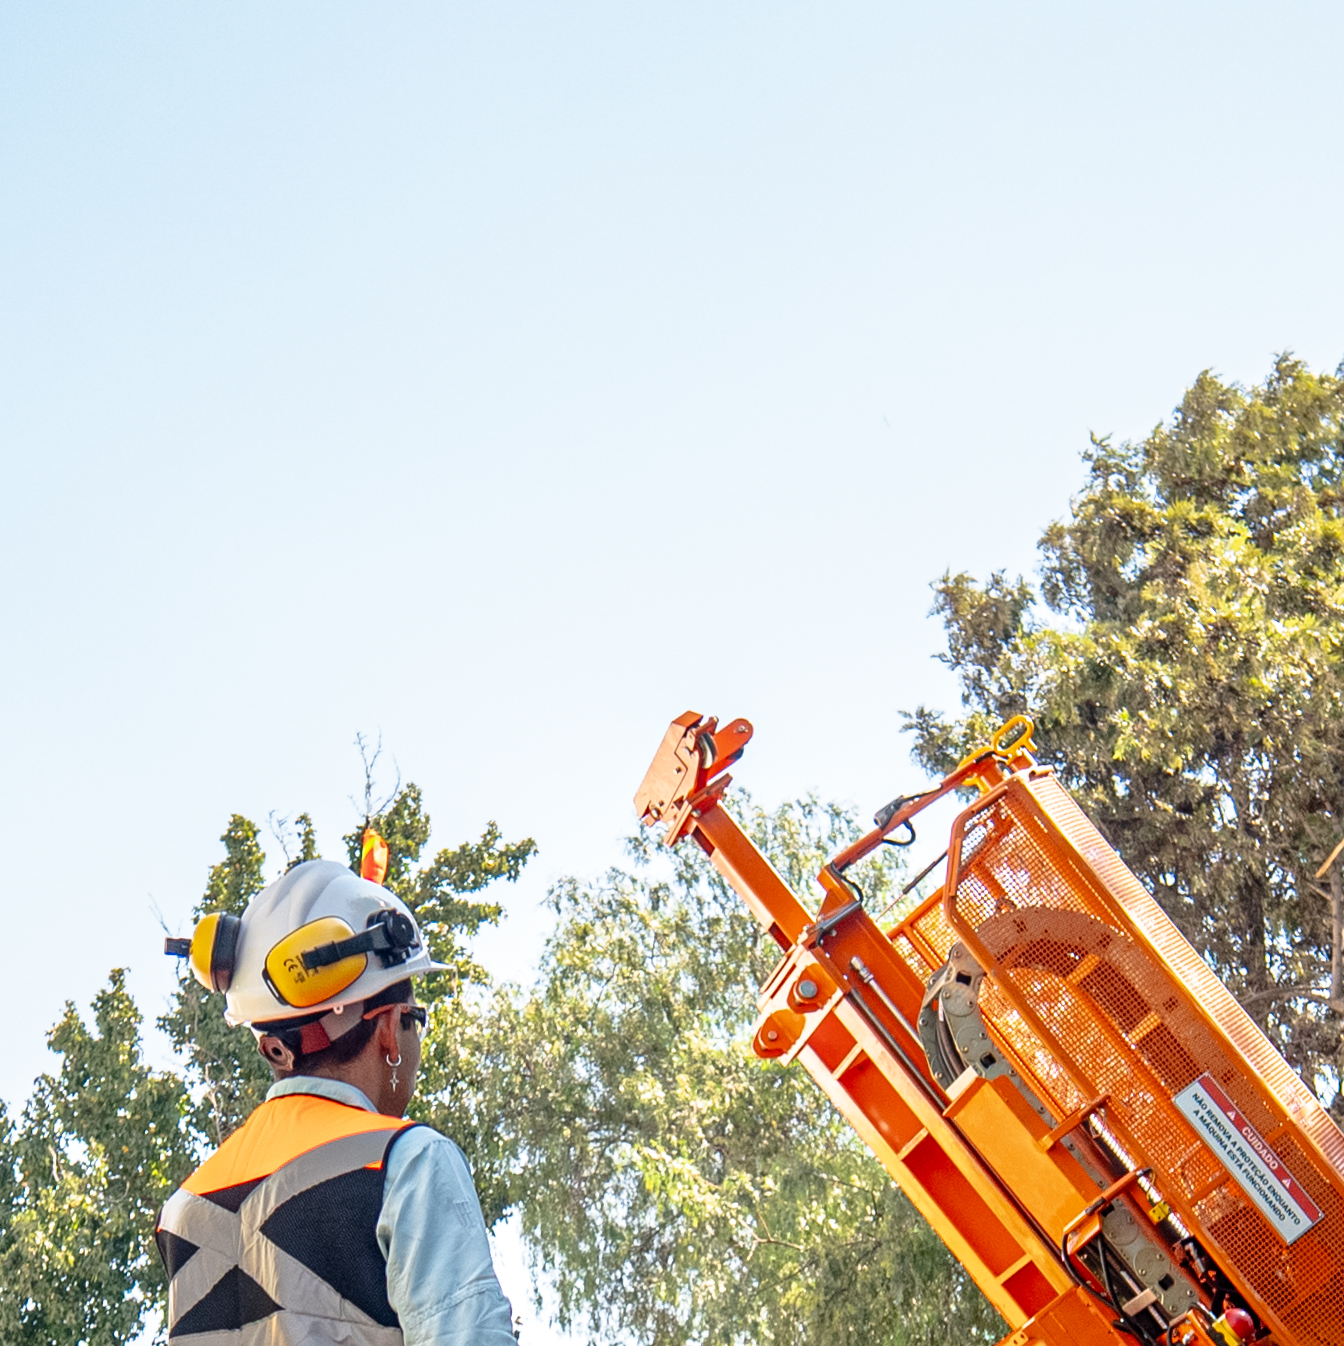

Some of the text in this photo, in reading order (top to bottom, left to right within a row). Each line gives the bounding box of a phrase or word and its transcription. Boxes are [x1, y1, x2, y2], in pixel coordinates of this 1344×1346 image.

[1192, 1093, 1207, 1110] NÃO
[1206, 1108, 1232, 1141] REMOVA
[1237, 1145, 1268, 1186] PROTEÇÃO
[1267, 1182, 1301, 1226] ENQUANTO
[1199, 1114, 1228, 1151] MÁQUINA
[1227, 1149, 1244, 1170] ESTÁ
[1242, 1168, 1286, 1222] FUNCIONANDO
[1241, 1126, 1278, 1170] CUIDADO
